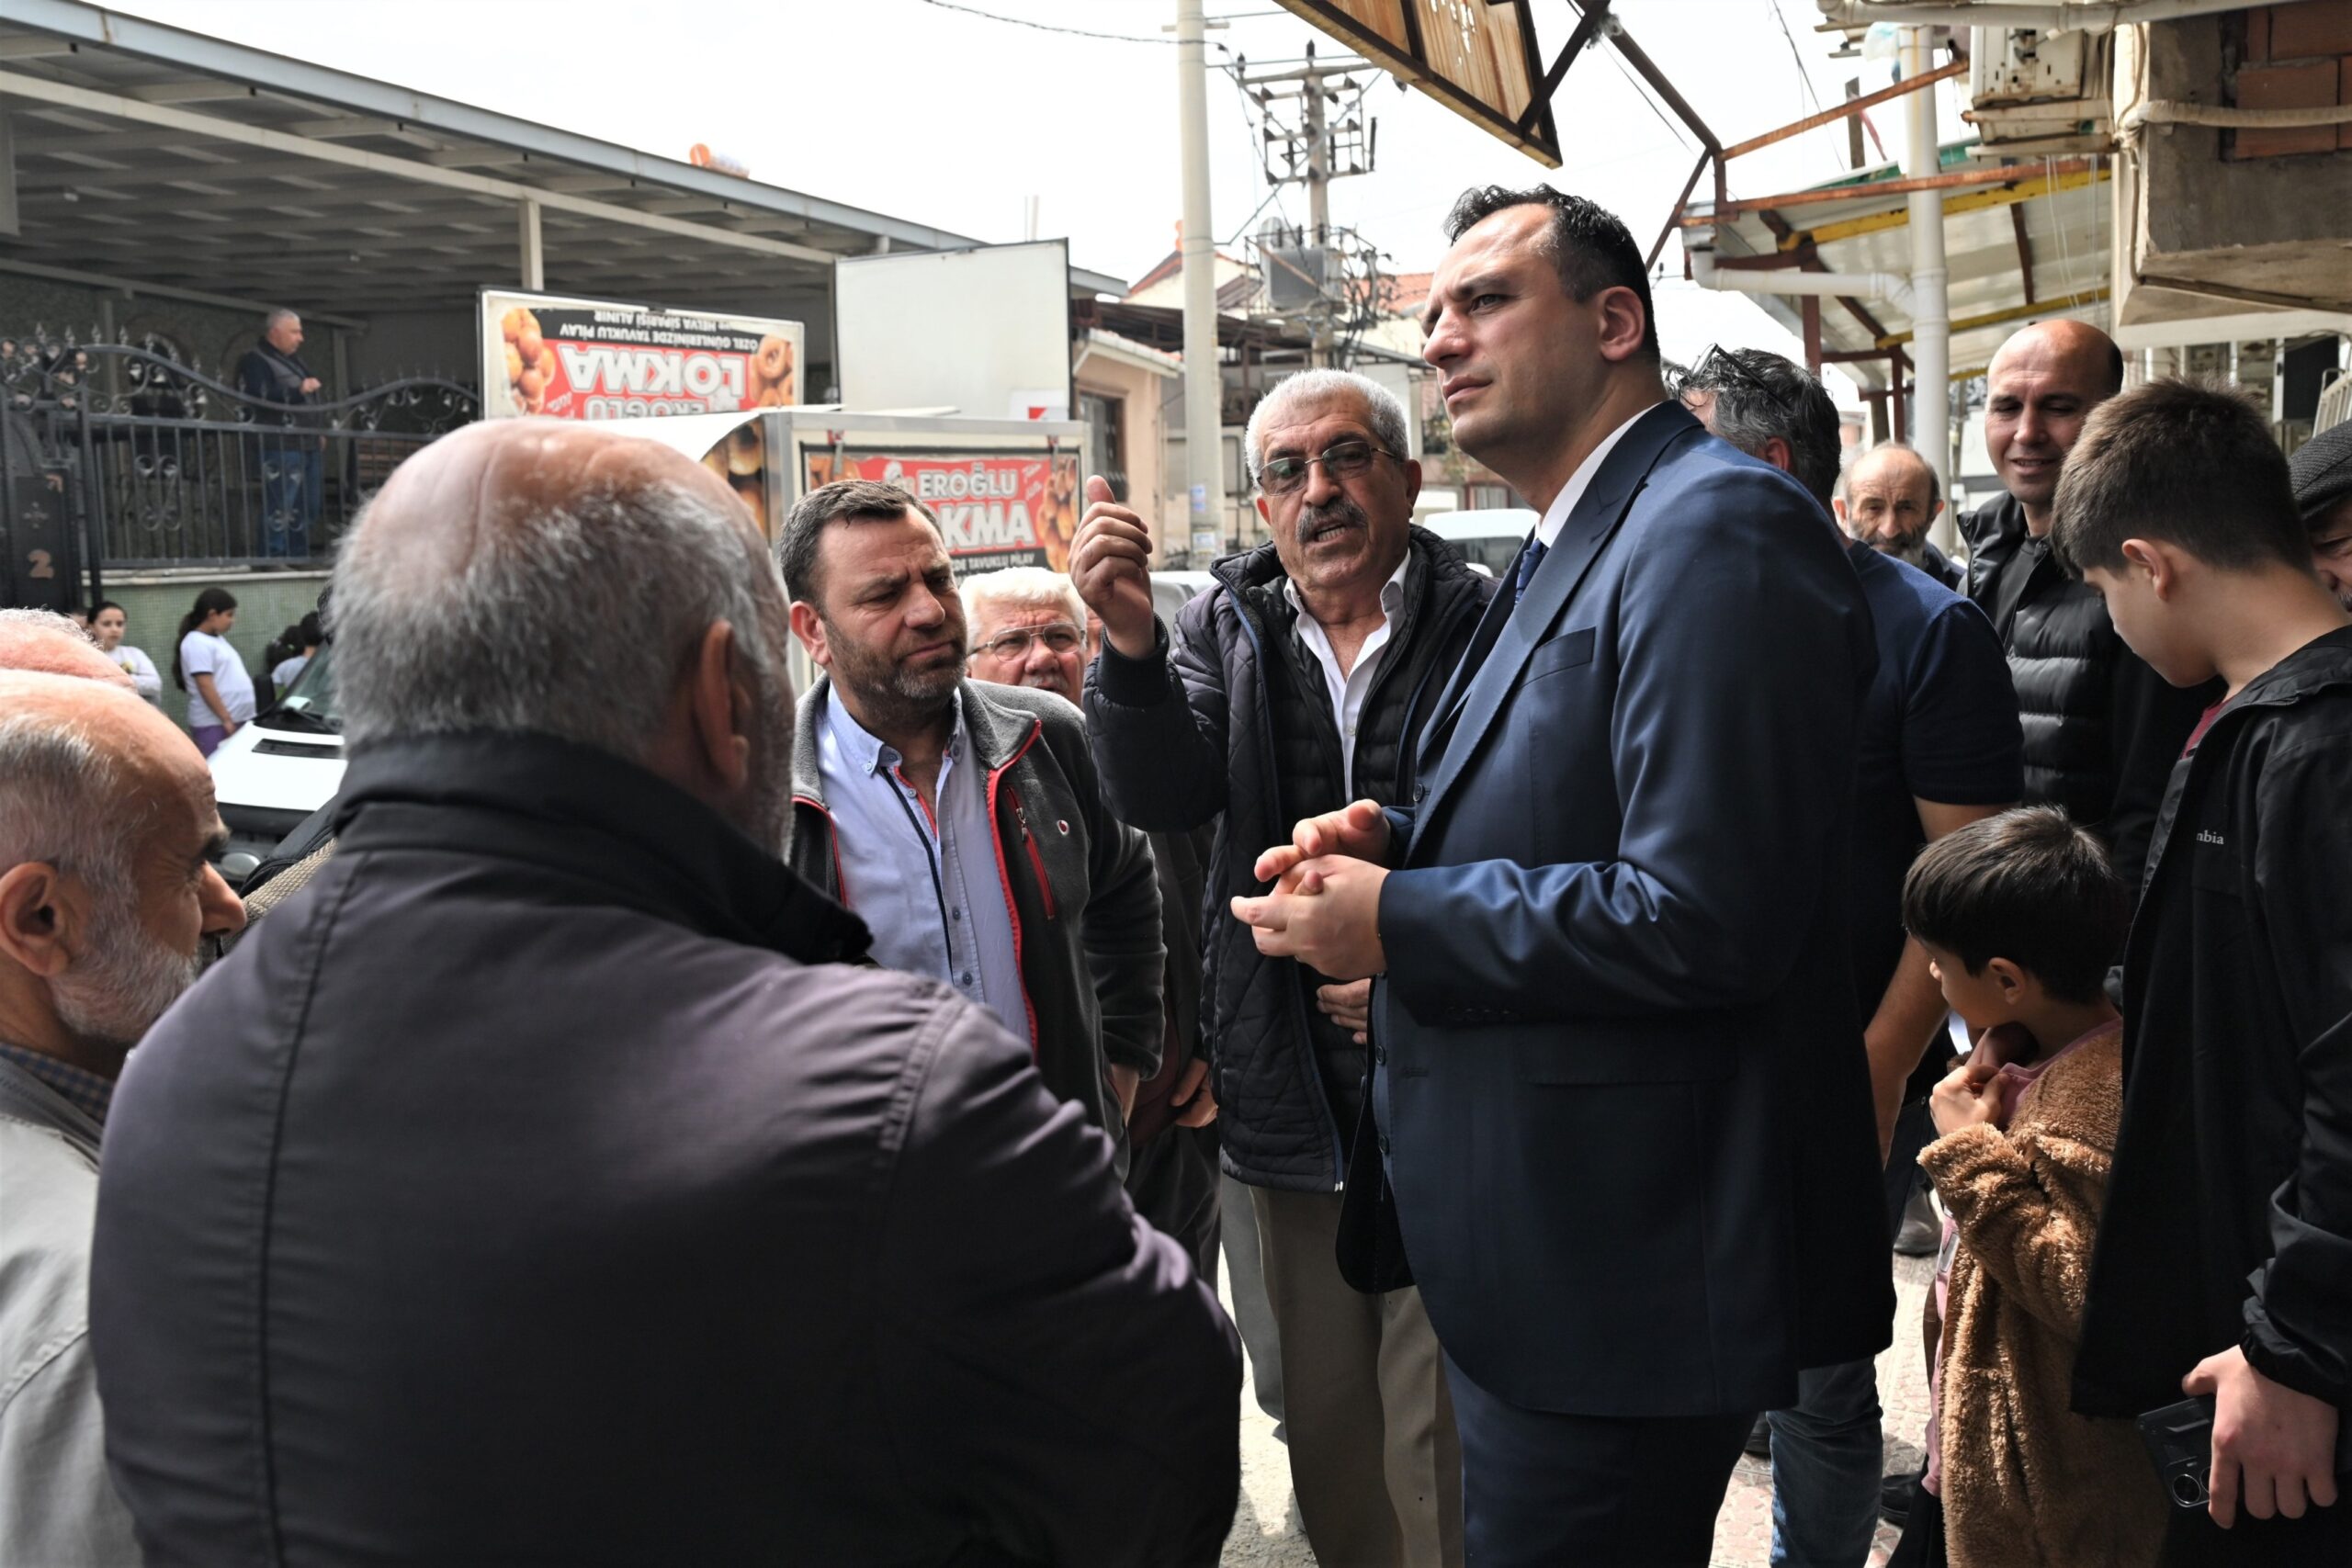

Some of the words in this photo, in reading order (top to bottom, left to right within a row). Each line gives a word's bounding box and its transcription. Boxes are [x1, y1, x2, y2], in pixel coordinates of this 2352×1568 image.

[594, 310, 632, 325] ALINIR
[683, 317, 718, 332] HELVA
[560, 323, 594, 341] PİLAV
[597, 325, 650, 343] TAVUKLU
[653, 330, 731, 350] GÜNLERİNİZDE
[732, 337, 759, 352] ÖZEL
[560, 344, 744, 396] LOKMA
[918, 463, 1017, 498] EROĞLU
[940, 503, 1035, 549] KMA
[28, 549, 54, 579] 2
[967, 555, 1009, 570] TAVUKLU
[1010, 552, 1035, 566] PİLAV
